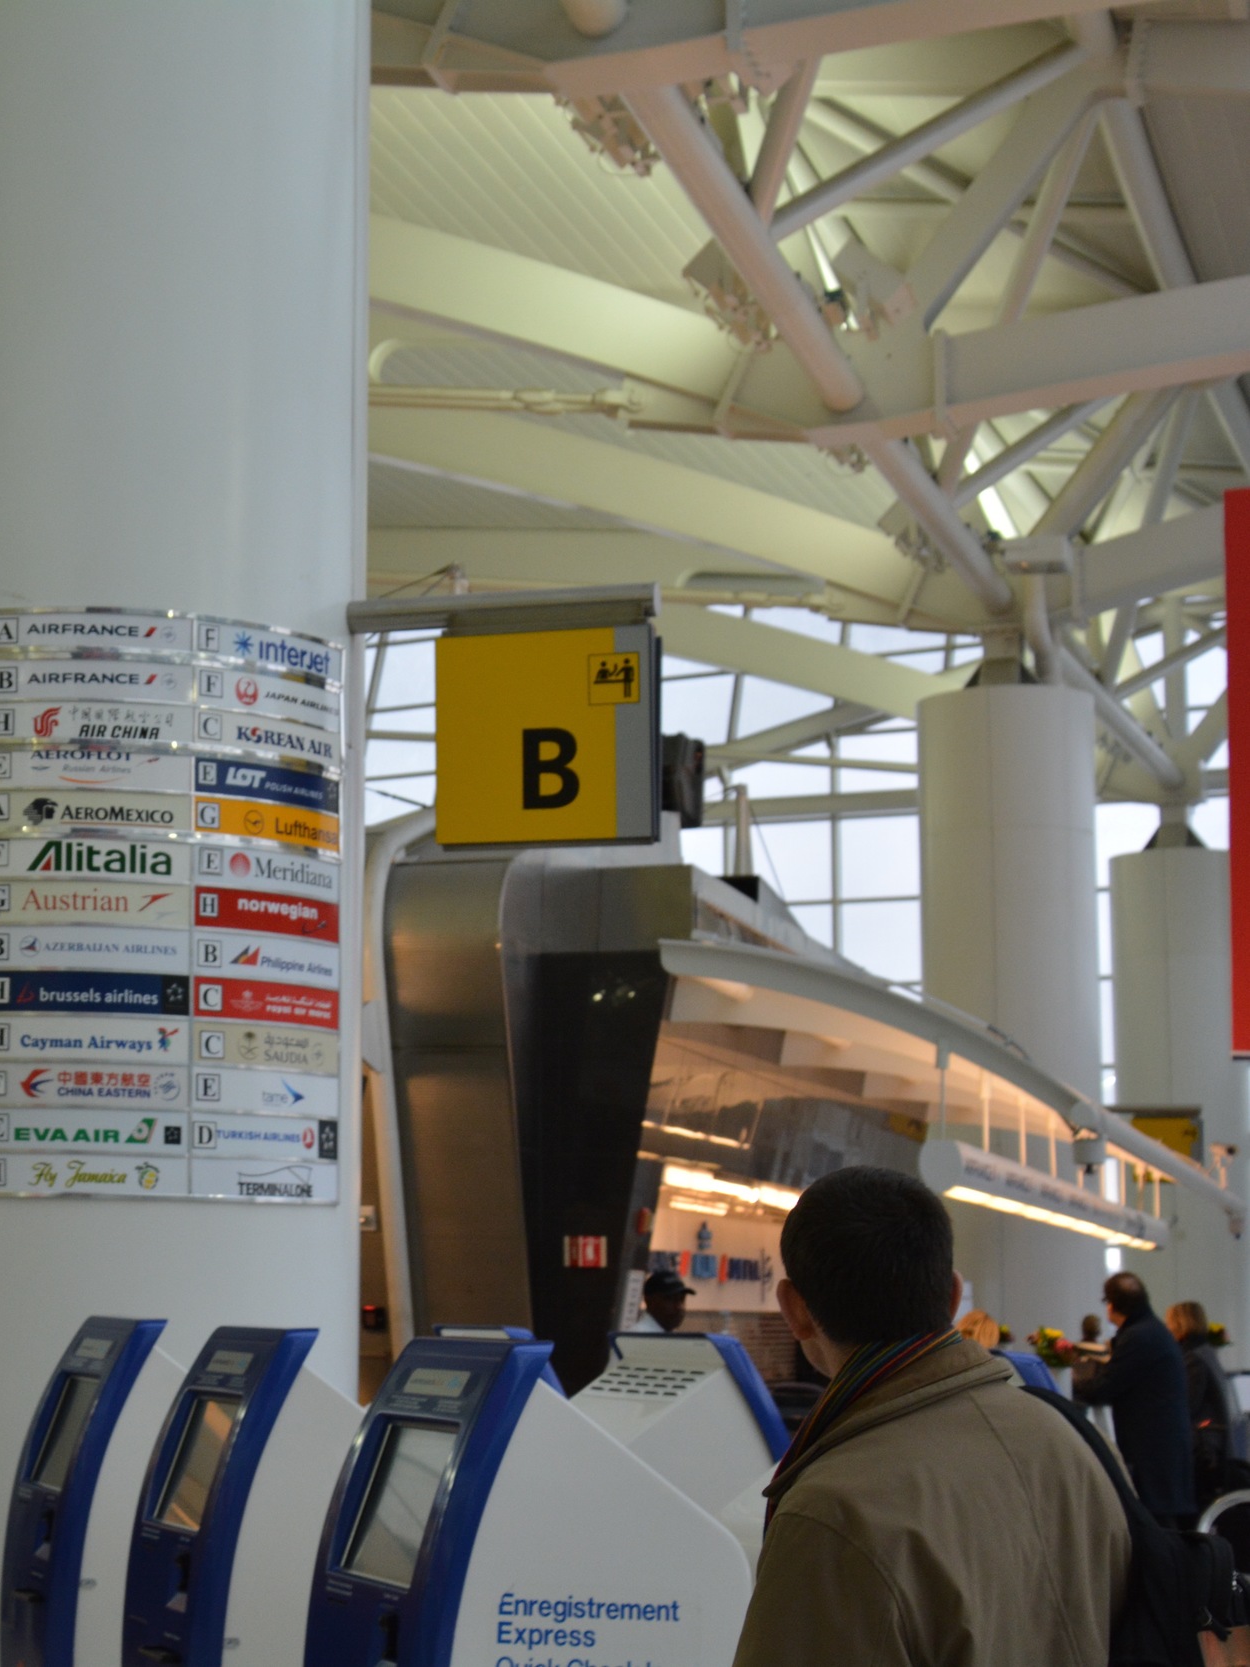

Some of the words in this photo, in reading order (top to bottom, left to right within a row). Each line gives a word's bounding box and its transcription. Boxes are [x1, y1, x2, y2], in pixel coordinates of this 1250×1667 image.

[27, 623, 139, 637] AIRFRANCE
[205, 628, 216, 648] F
[258, 640, 331, 675] interjet
[27, 672, 139, 685] AIRFRANCE
[206, 674, 218, 693] F
[265, 691, 298, 704] JAPAN
[79, 724, 107, 738] AIR
[111, 725, 160, 739] CHINA
[203, 717, 218, 736] C
[237, 726, 305, 752] KOREAN
[307, 739, 333, 758] AIR
[30, 750, 131, 761] AEROFLOT
[62, 763, 95, 773] Russian
[100, 764, 132, 774] Airlines
[202, 764, 214, 782] E
[225, 767, 267, 788] LOT
[522, 727, 580, 810] B
[264, 781, 292, 792] POLISH
[293, 787, 323, 800] AIRLINES
[200, 805, 216, 825] G
[275, 817, 338, 844] Lufthansa
[27, 840, 172, 876] Alitalia
[206, 853, 218, 870] E
[254, 857, 333, 889] Meridiana
[22, 888, 129, 912] Austrian
[202, 897, 215, 913] H
[238, 898, 319, 920] norwegian
[44, 942, 119, 952] AZERBAIJAN
[123, 944, 177, 956] AIRLINES
[203, 944, 217, 963] B
[260, 956, 305, 972] Philippine
[306, 962, 333, 977] Airlines
[40, 987, 101, 1003] brussels
[104, 989, 159, 1005] airlines
[203, 987, 218, 1007] C
[20, 1034, 83, 1051] Cayman
[87, 1036, 152, 1053] Airways
[205, 1035, 221, 1055] C
[264, 1049, 309, 1065] SAUDIA
[57, 1087, 94, 1097] CHINA
[98, 1087, 151, 1098] EASTERN
[203, 1078, 216, 1097] E
[14, 1127, 69, 1141] EVA
[72, 1128, 120, 1143] AIR
[198, 1125, 213, 1145] D
[216, 1130, 261, 1141] TURKISH
[262, 1131, 301, 1143] AIRLINES
[28, 1162, 58, 1187] Fly
[65, 1160, 128, 1188] Jamaica
[498, 1593, 680, 1623] Enregistrement
[497, 1621, 597, 1650] Express
